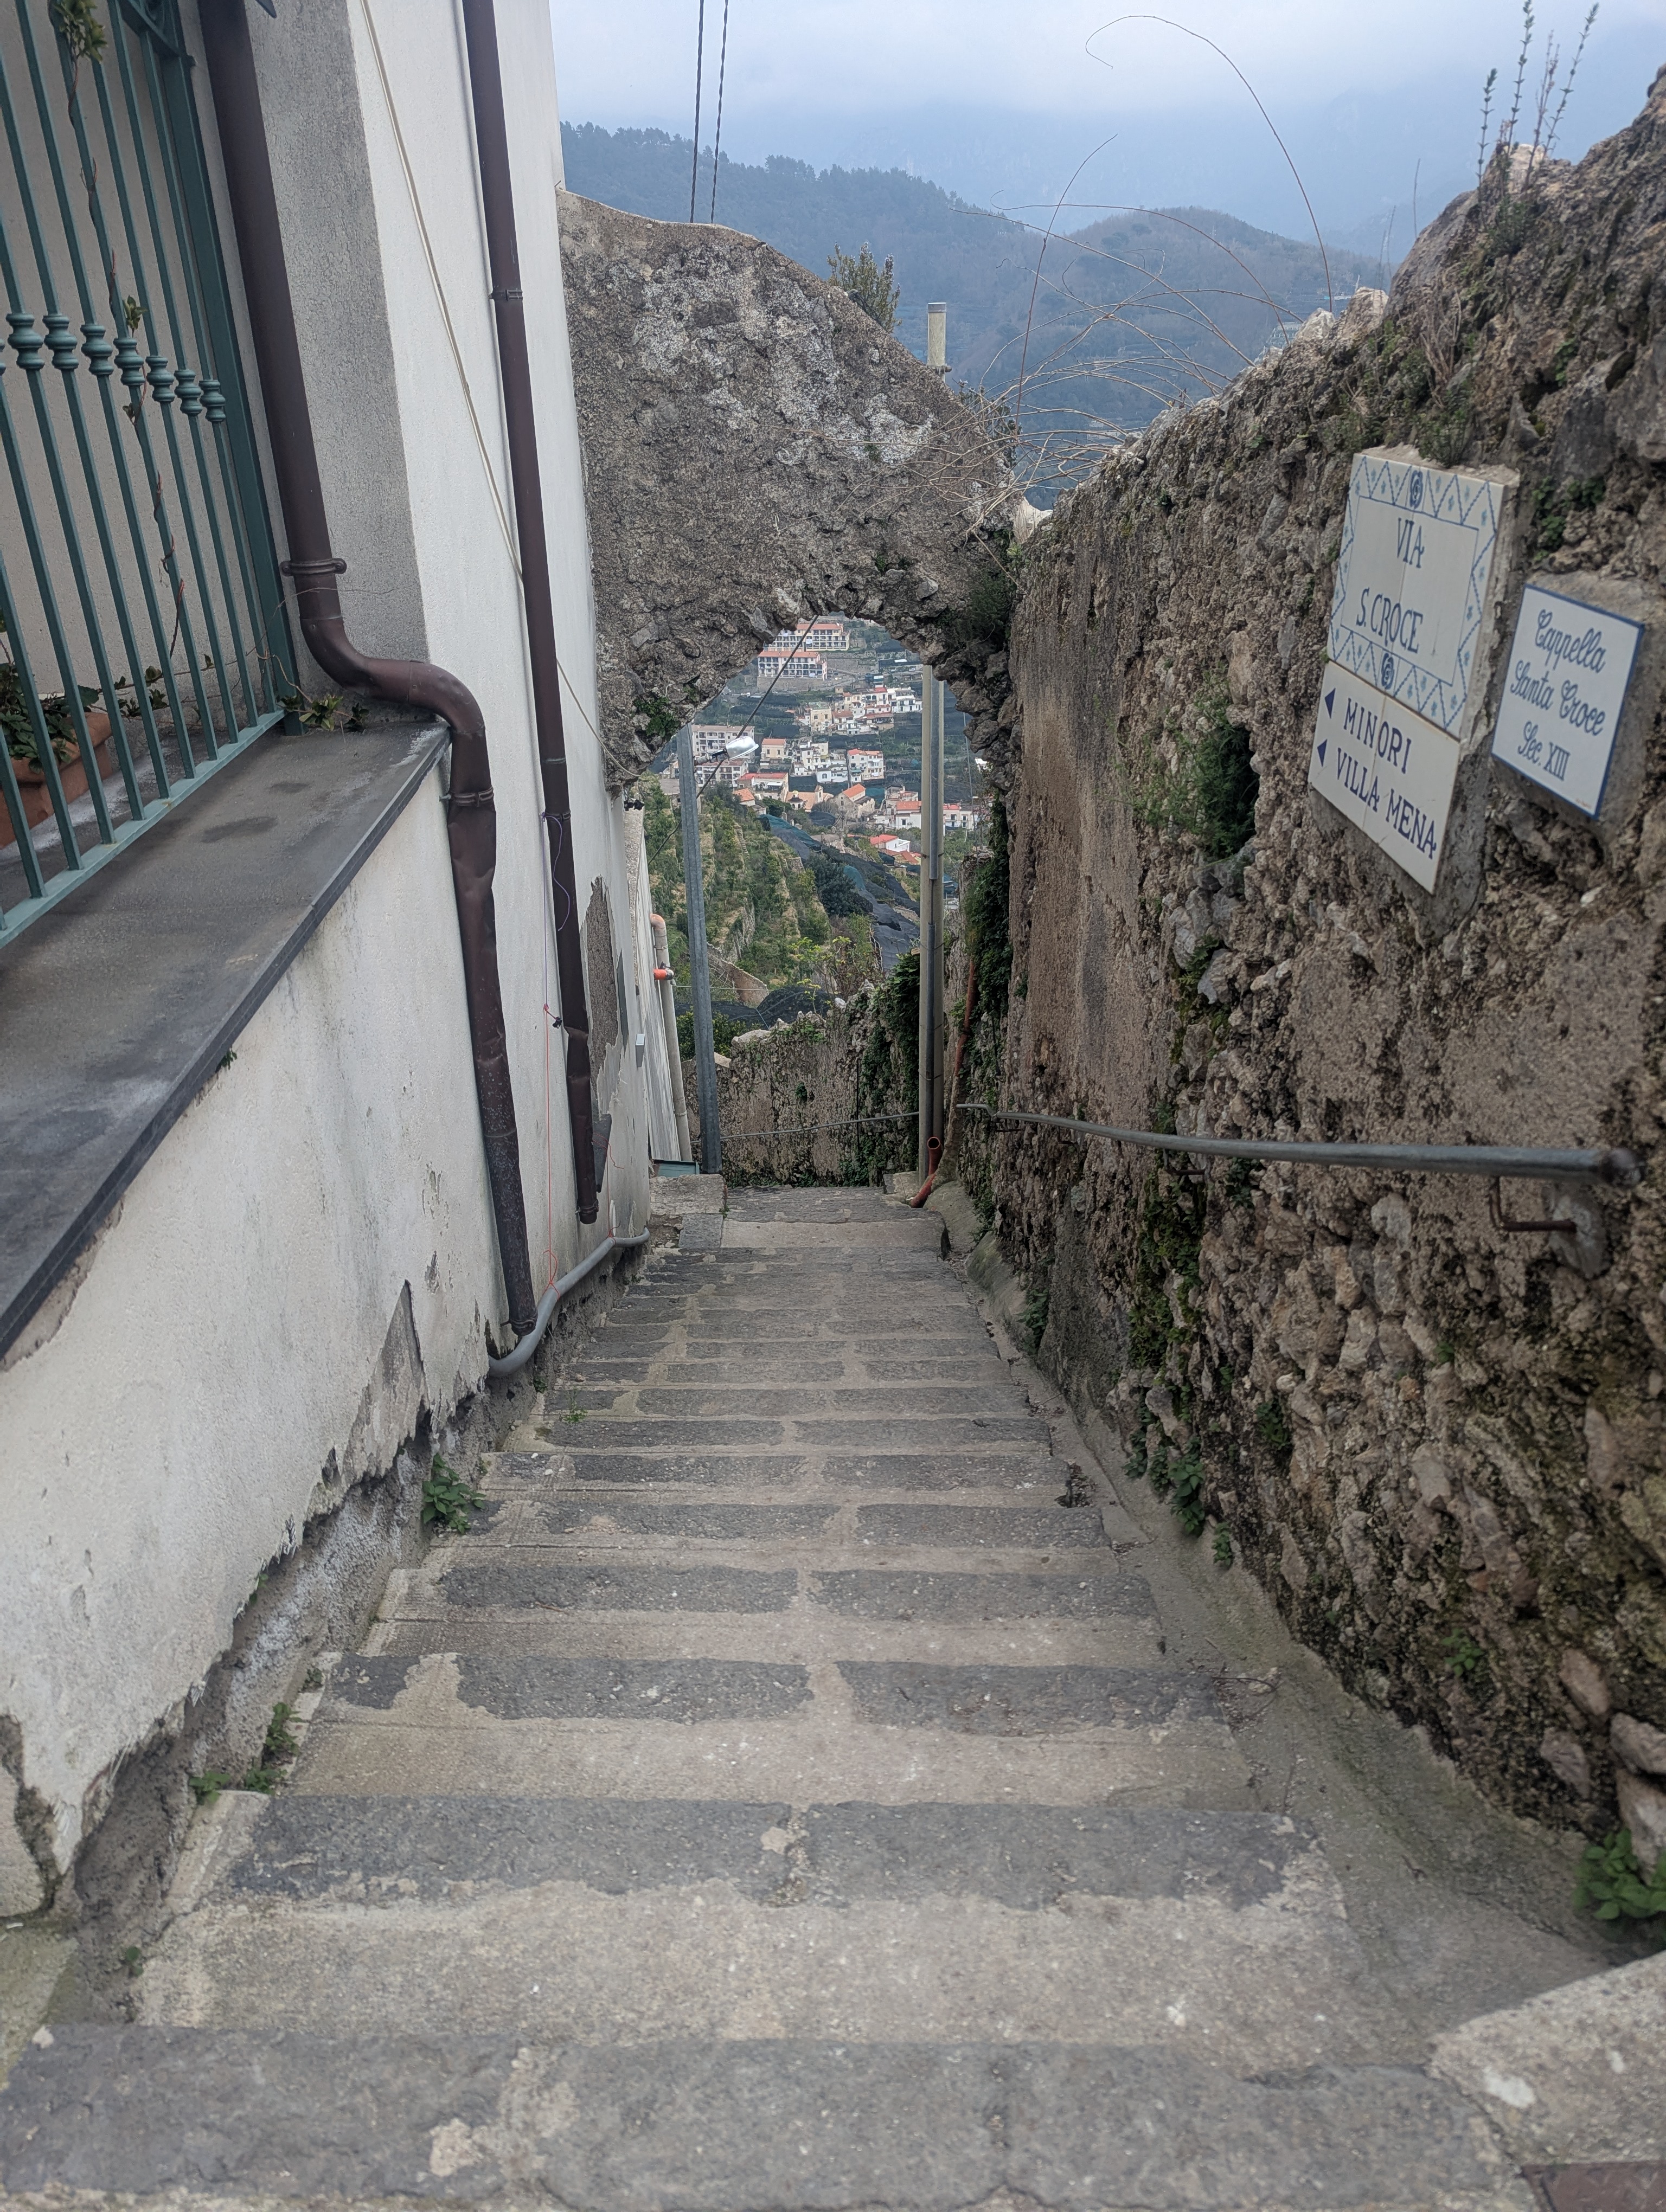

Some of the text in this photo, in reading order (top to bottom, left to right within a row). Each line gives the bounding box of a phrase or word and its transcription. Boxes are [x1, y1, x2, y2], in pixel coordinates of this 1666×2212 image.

[1396, 517, 1425, 568] VIA
[1534, 609, 1607, 674] Cappella
[1510, 660, 1606, 736] Santa Croce
[1343, 698, 1412, 774] MINORI
[1517, 721, 1571, 781] Sec. XIII
[1337, 748, 1437, 860] VILLA MENA
